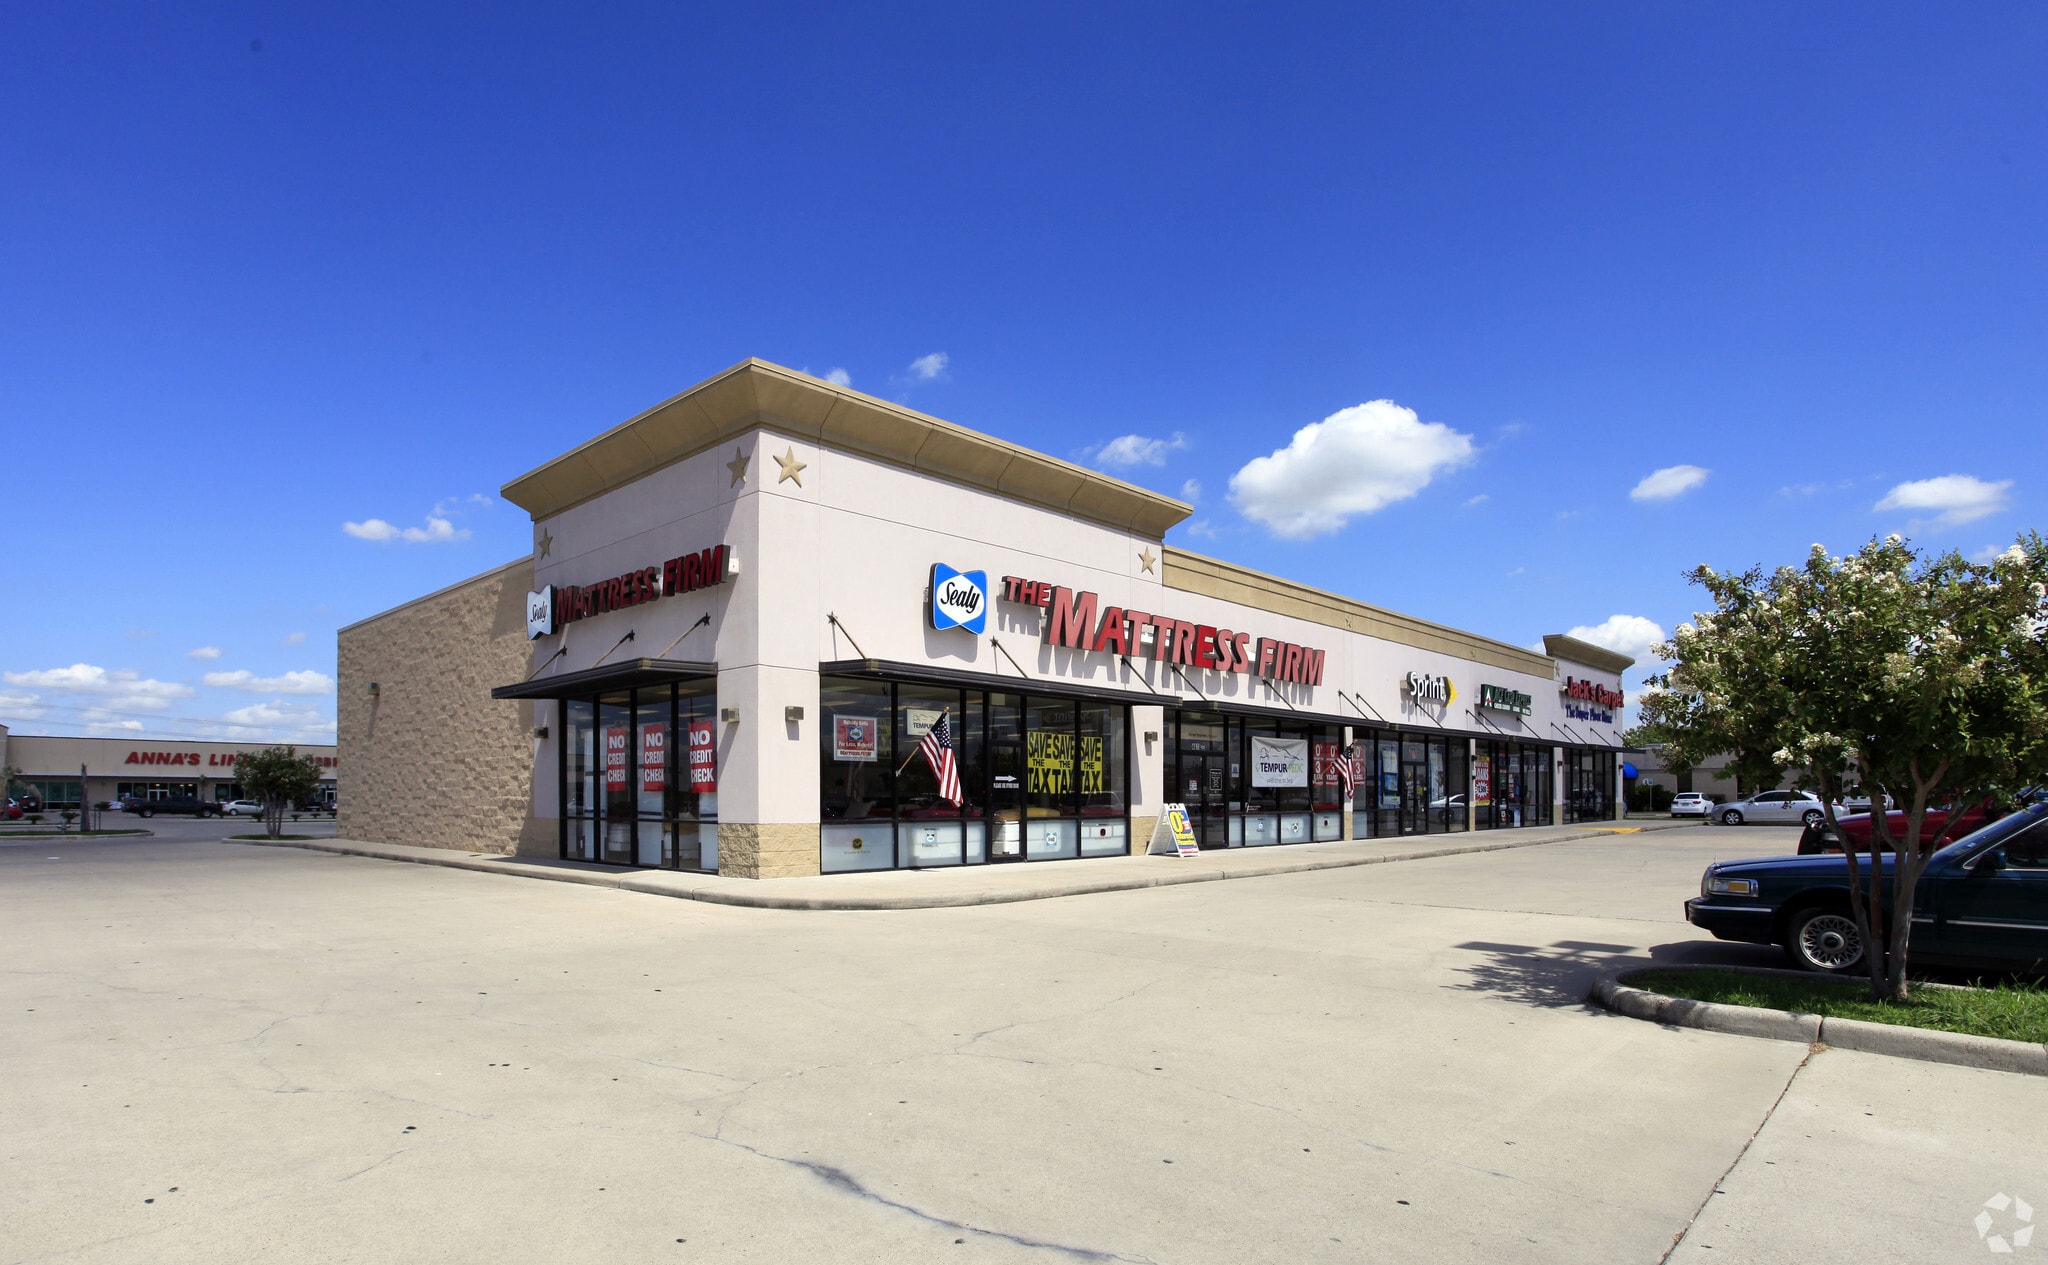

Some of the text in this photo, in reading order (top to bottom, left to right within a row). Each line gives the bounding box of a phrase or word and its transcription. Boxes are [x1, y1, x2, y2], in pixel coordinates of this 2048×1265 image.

[556, 544, 727, 624] MATTRESS FIRM
[1003, 576, 1051, 607] THE
[940, 582, 980, 614] Sealy
[530, 600, 548, 623] Sealy
[1048, 586, 1325, 686] MATTRESS FIRM
[1409, 671, 1444, 704] Sprint
[608, 735, 625, 749] NO
[645, 733, 663, 747] NO
[690, 730, 711, 746] NO
[1028, 732, 1052, 759] SAVE
[1052, 734, 1075, 760] SAVE
[1080, 736, 1101, 762] SAVE
[125, 752, 201, 766] ANNA'S
[607, 752, 626, 765] CREDIT
[644, 751, 664, 764] CREDIT
[690, 749, 712, 764] CREDIT
[1032, 759, 1045, 767] THE
[1059, 760, 1071, 768] THE
[1084, 762, 1095, 770] THE
[1315, 761, 1321, 774] 3
[1355, 762, 1361, 774] 3
[607, 769, 626, 782] CHECK
[644, 768, 664, 782] CHECK
[691, 768, 714, 783] CHECK
[1028, 768, 1052, 793] TAX
